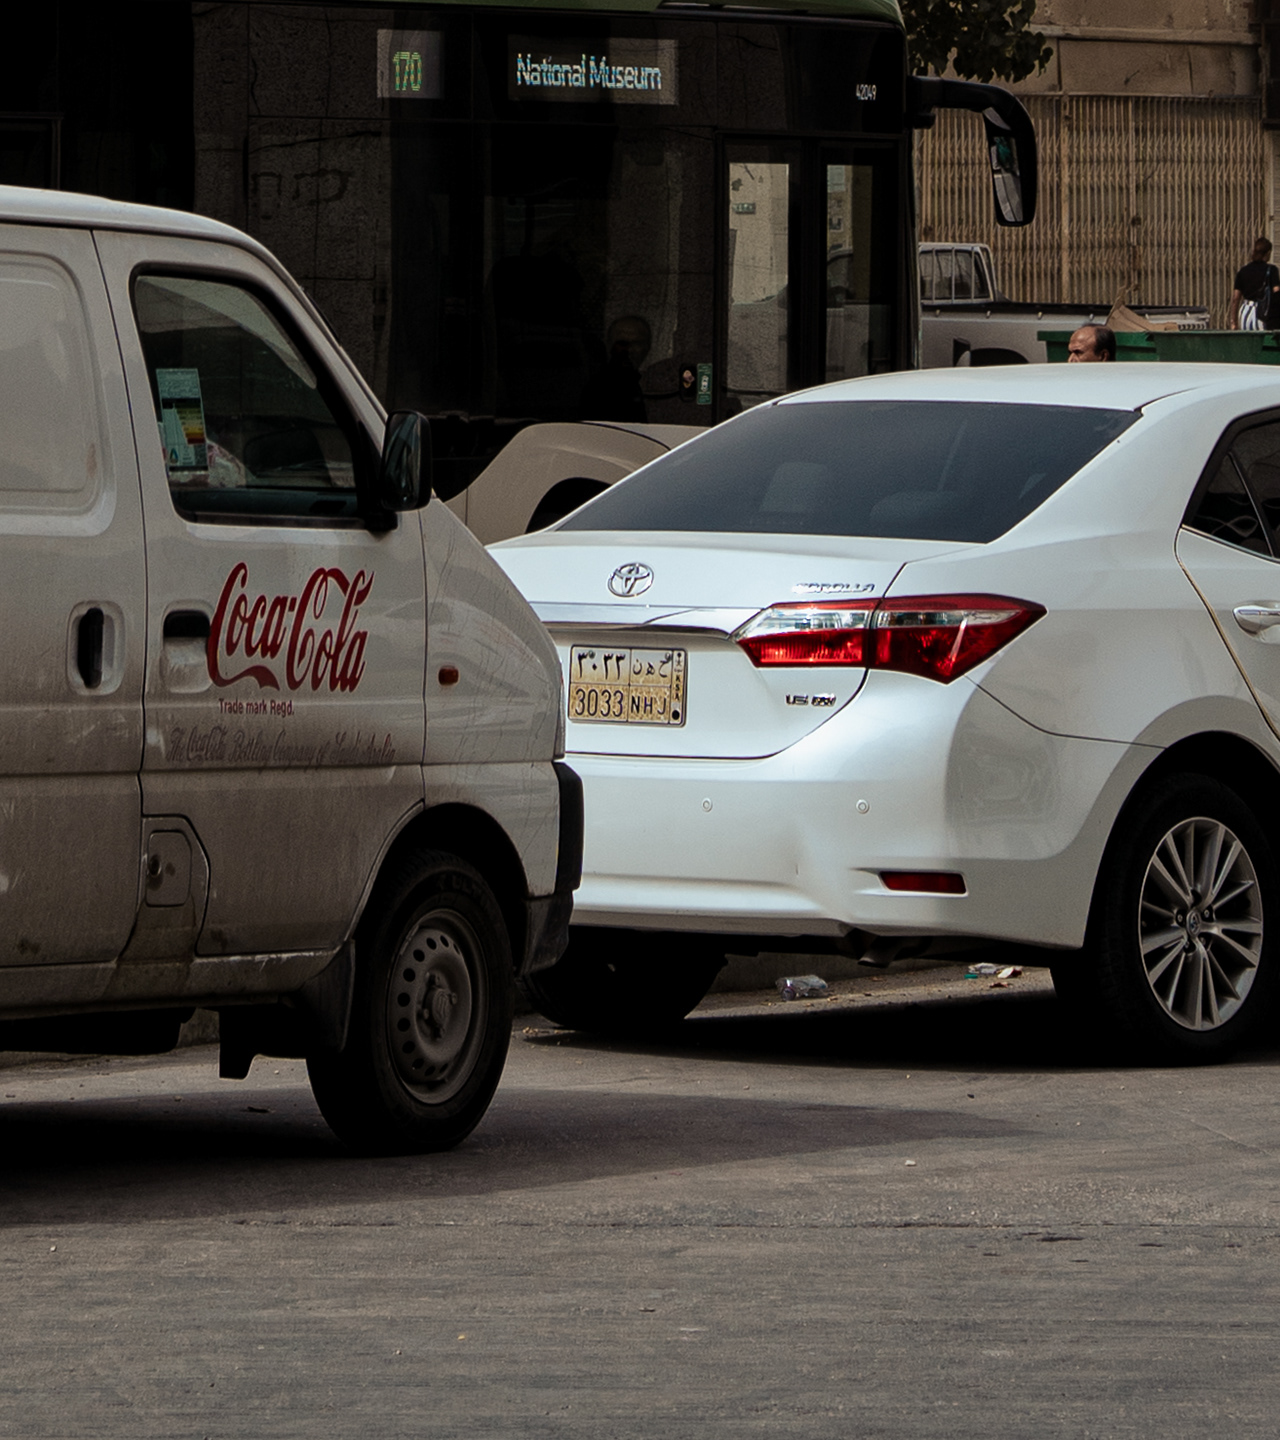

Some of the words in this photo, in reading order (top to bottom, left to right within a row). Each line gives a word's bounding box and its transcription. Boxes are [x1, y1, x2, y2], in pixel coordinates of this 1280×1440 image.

[393, 52, 423, 92] 170
[517, 53, 586, 88] National
[590, 56, 662, 90] Museum
[219, 698, 243, 714] Trade
[246, 700, 267, 715] mark
[270, 700, 295, 718] Regd.
[575, 688, 623, 717] 3033
[631, 696, 667, 715] NHJ
